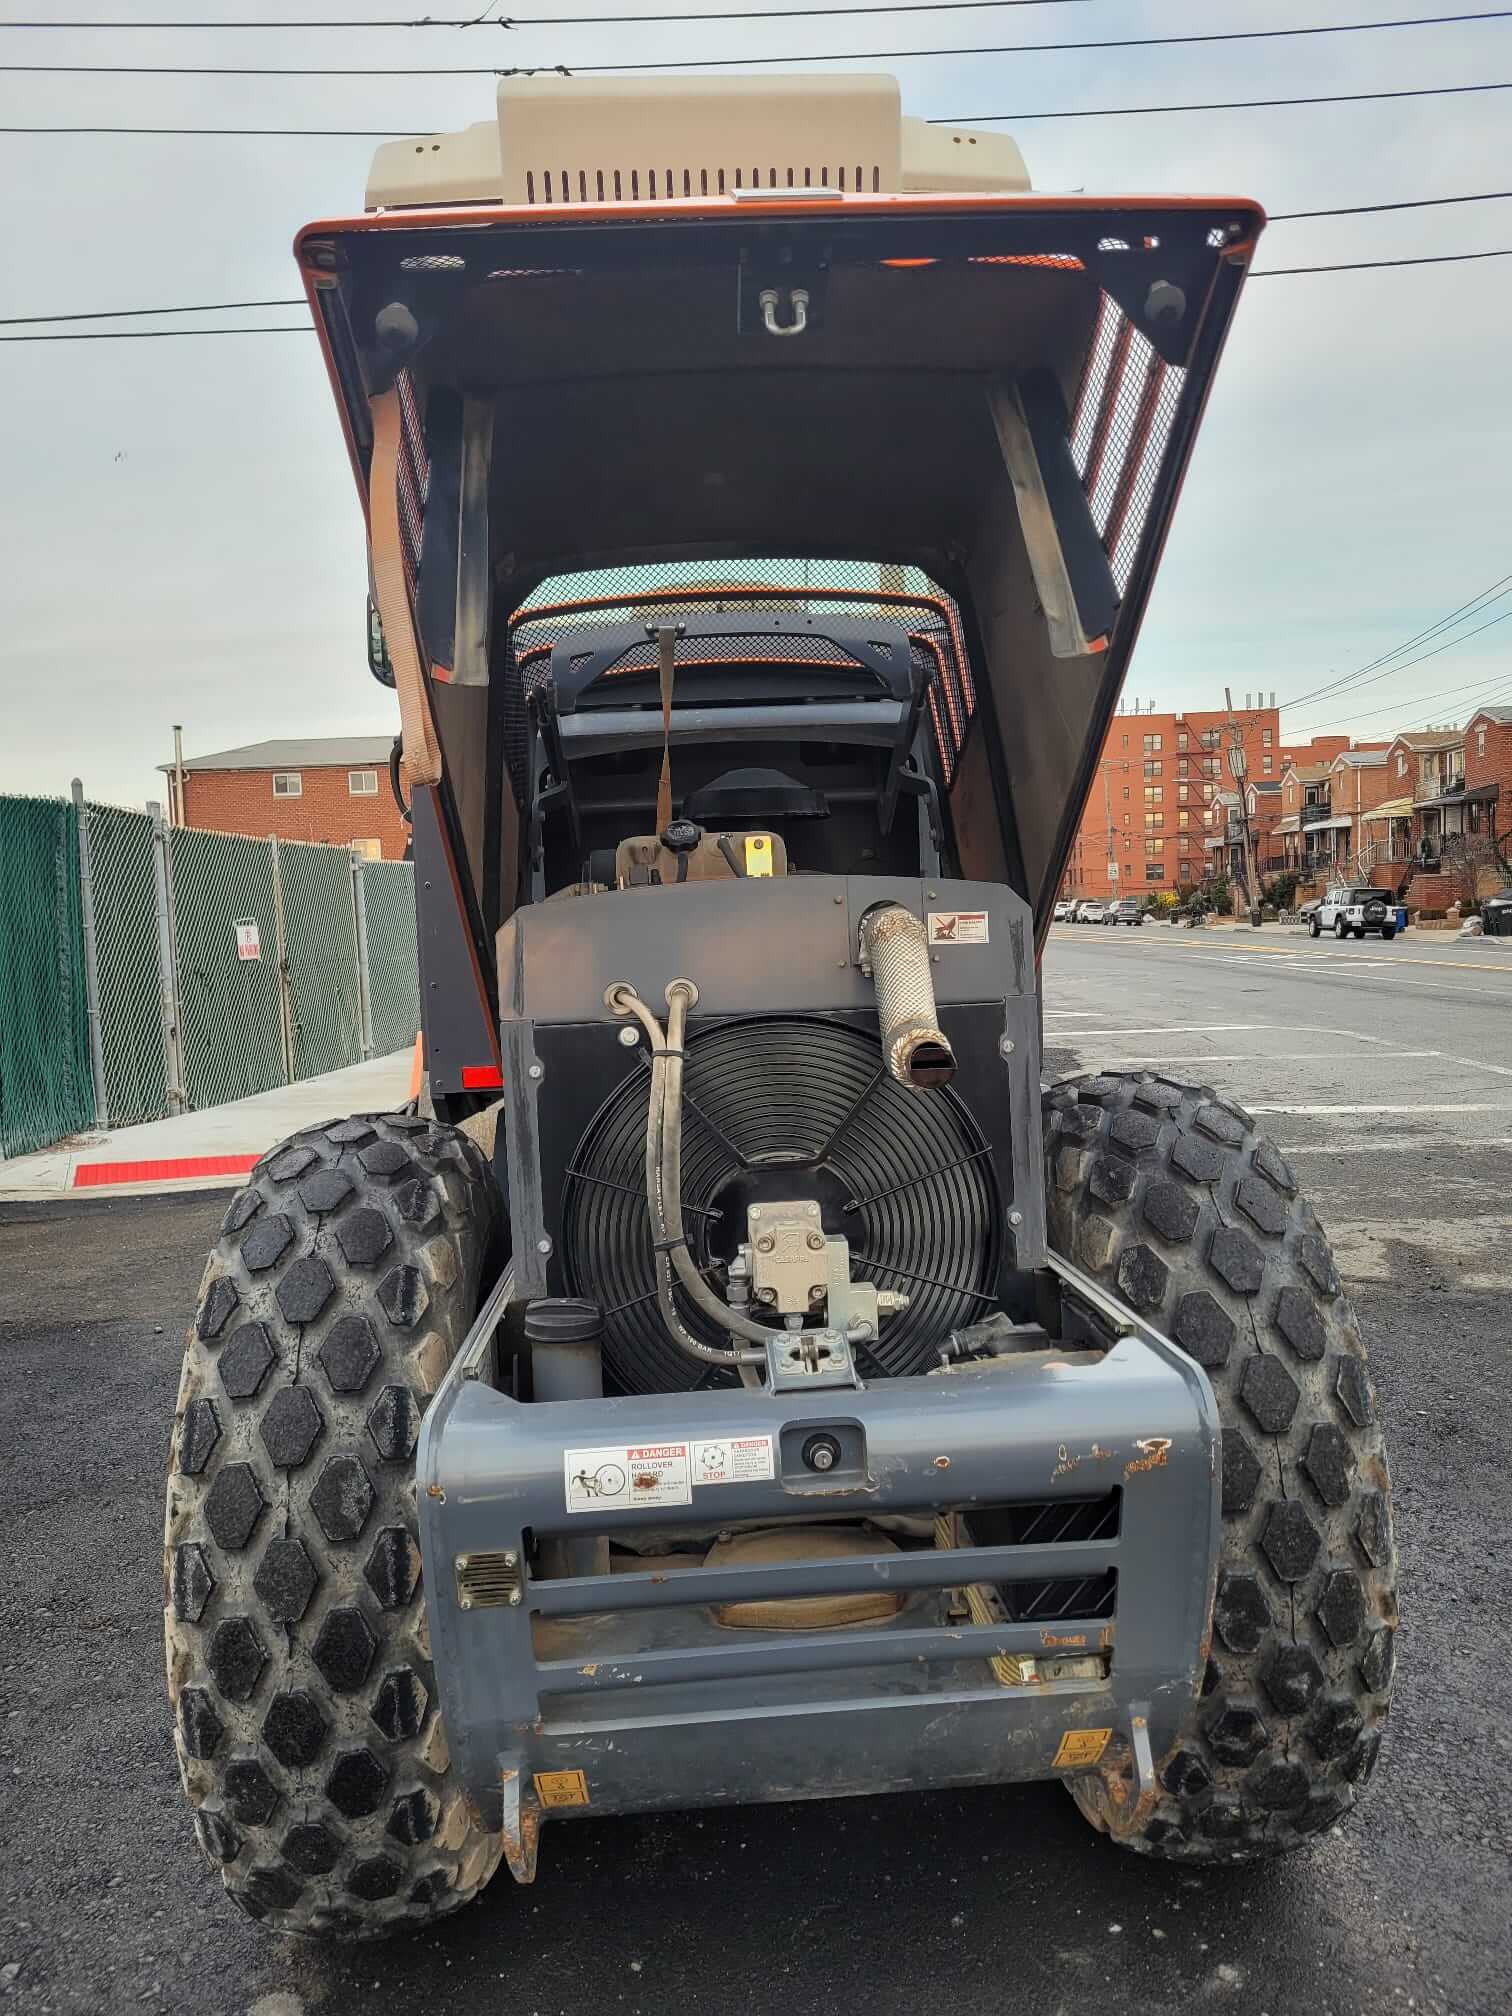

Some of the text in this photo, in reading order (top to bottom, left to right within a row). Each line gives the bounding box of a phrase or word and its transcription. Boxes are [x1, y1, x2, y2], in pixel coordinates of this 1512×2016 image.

[642, 1447, 682, 1457] DANGER
[632, 1461, 673, 1470] ROLLOVER
[703, 1472, 725, 1480] STOP
